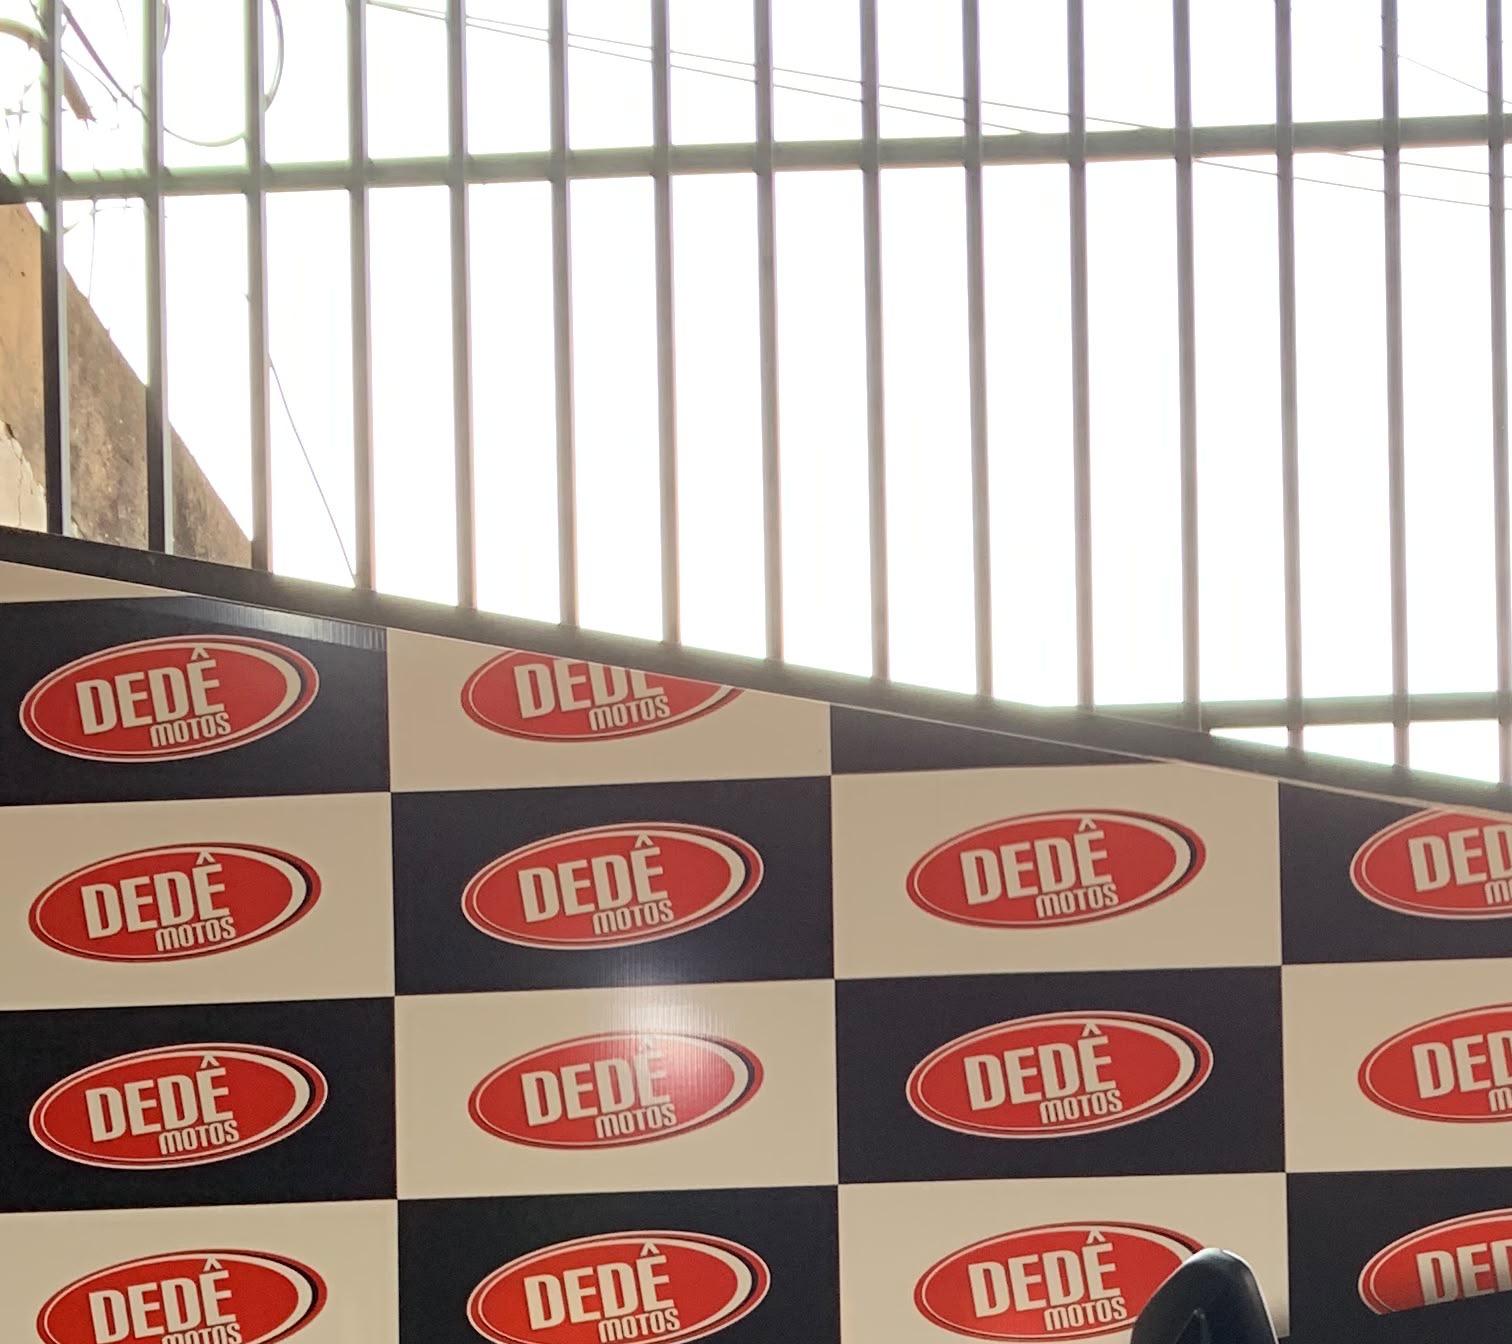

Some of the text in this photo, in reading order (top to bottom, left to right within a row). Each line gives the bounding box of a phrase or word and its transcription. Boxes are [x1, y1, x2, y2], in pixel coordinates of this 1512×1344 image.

[76, 645, 225, 735] DEDÊ
[150, 712, 232, 748] MOTOS
[589, 695, 671, 731] MOTOS
[518, 833, 668, 923] DEDÊ
[960, 816, 1113, 905] DEDÊ
[81, 850, 230, 939] DEDÊ
[1035, 883, 1119, 918] MOTOS
[155, 916, 236, 952] MOTOS
[592, 899, 674, 935] MOTOS
[963, 1021, 1117, 1111] DEDÊ
[85, 1053, 234, 1142] DEDÊ
[1039, 1089, 1123, 1125] MOTOS
[158, 1120, 240, 1155] MOTOS
[595, 1104, 678, 1139] MOTOS
[524, 1241, 675, 1330] DEDÊ
[968, 1229, 1121, 1318] DEDÊ
[89, 1256, 237, 1344] DEDÊ
[1043, 1296, 1127, 1332] MOTOS
[598, 1308, 681, 1343] MOTOS
